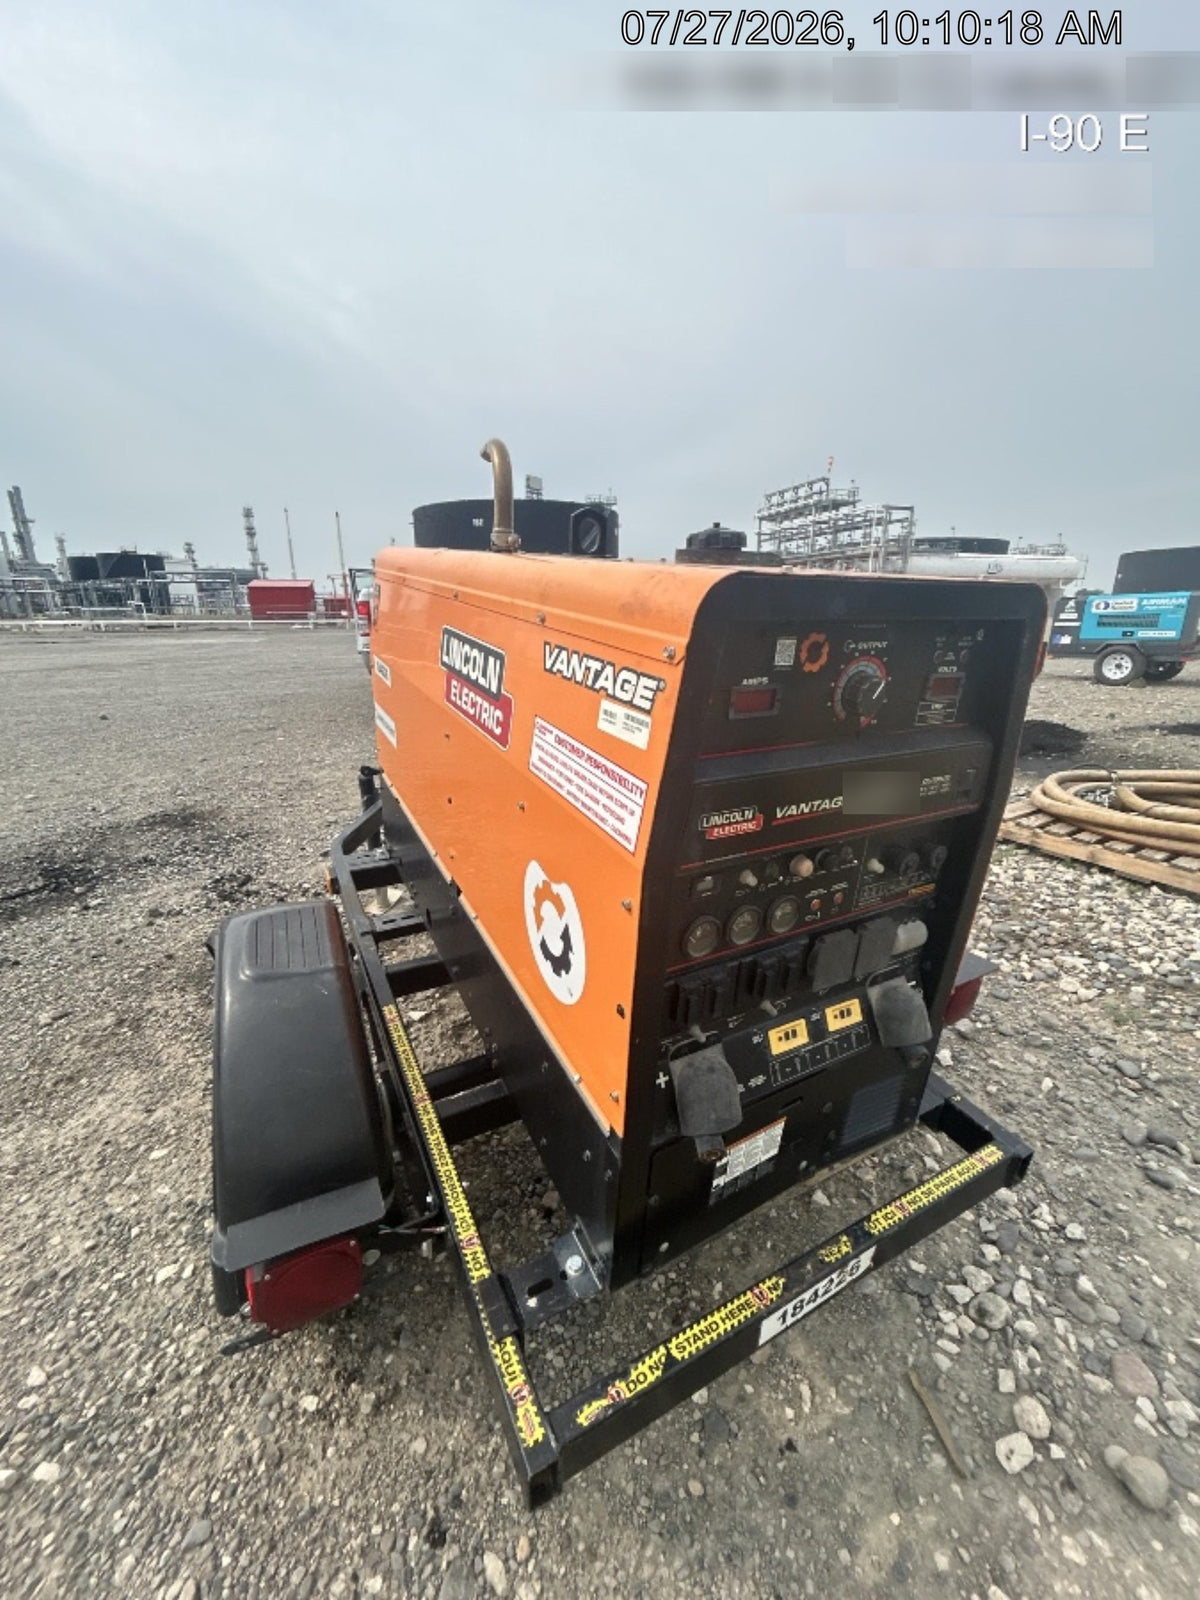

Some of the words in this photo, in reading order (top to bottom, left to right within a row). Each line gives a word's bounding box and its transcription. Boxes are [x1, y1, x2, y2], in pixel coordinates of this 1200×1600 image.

[442, 633, 500, 695] LINCOLN
[544, 643, 660, 711] VANTAGE
[741, 677, 769, 685] AMPS
[450, 679, 504, 735] ELECTRIC
[702, 810, 753, 827] LINCOLN
[712, 821, 758, 836] ELECTRIC
[776, 796, 843, 818] VANTAG
[442, 1168, 466, 1214] DEBOUT
[625, 1371, 648, 1394] DO
[650, 1354, 668, 1376] NO
[674, 1320, 720, 1354] STAND
[720, 1300, 754, 1326] HERE
